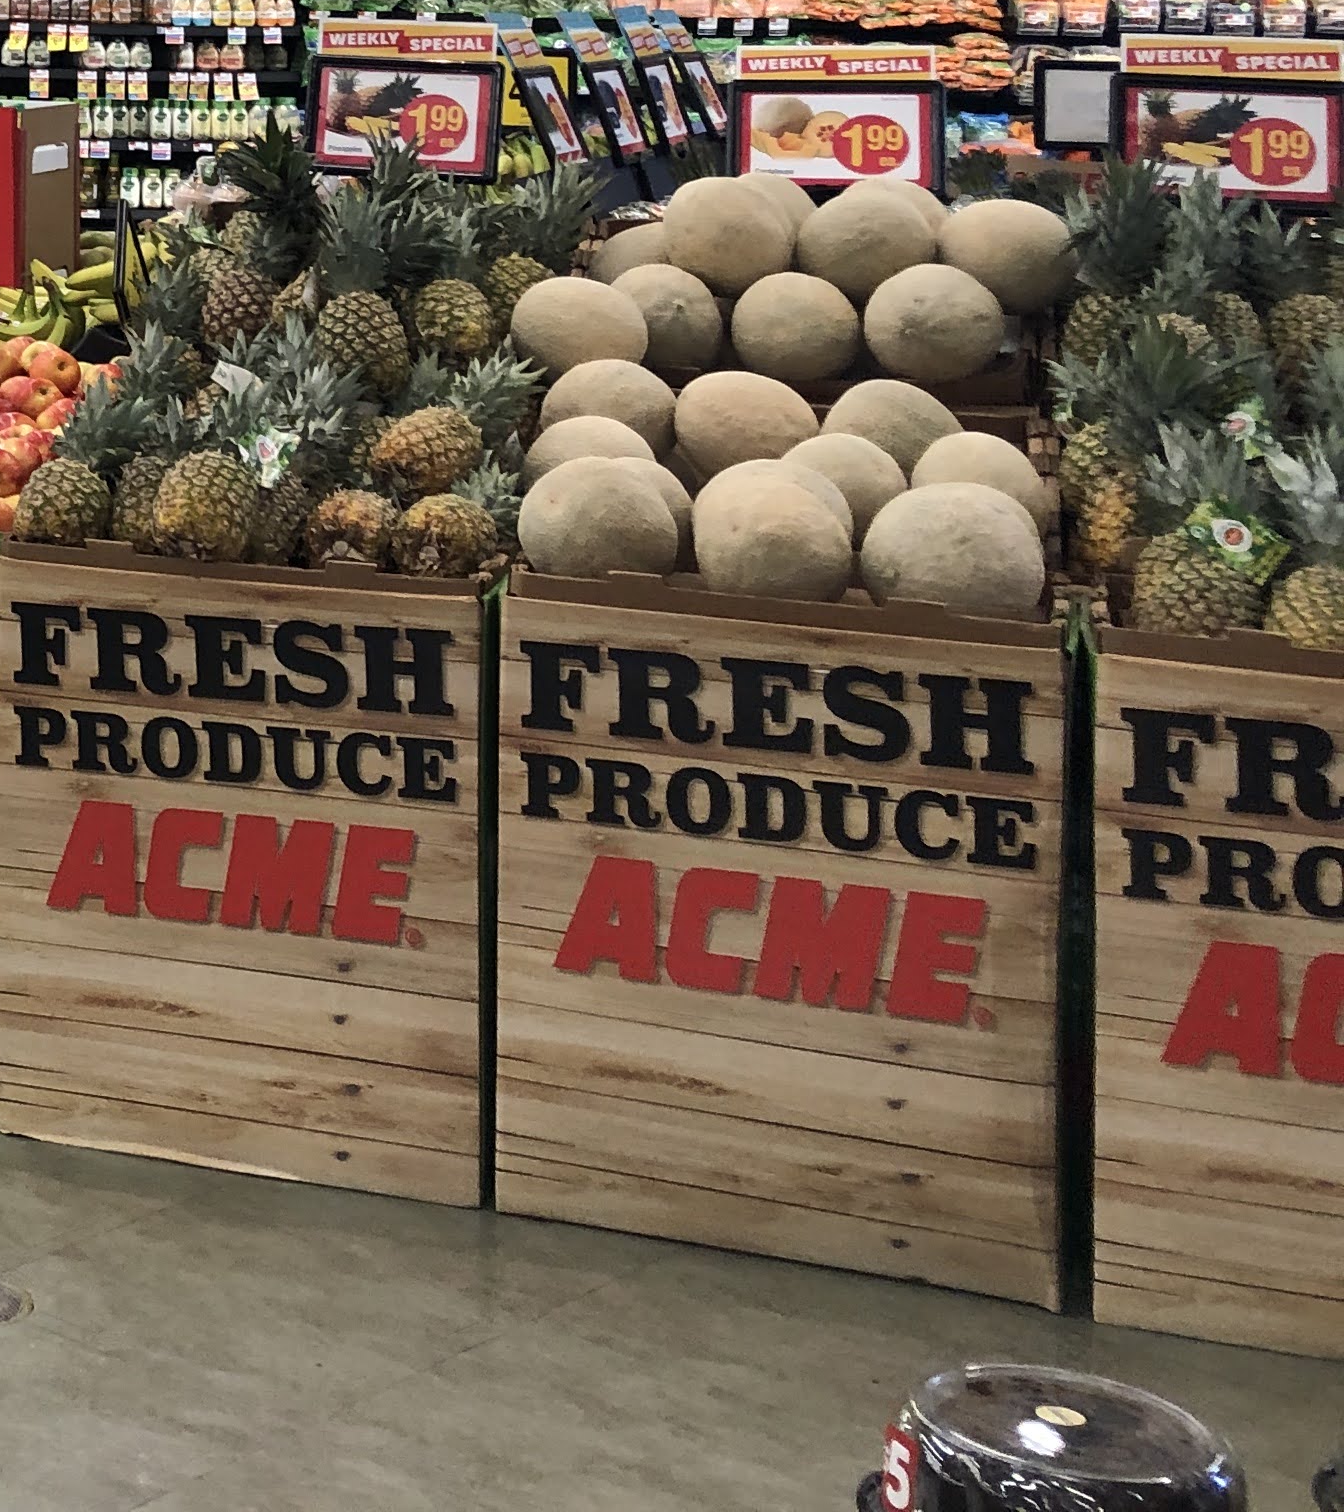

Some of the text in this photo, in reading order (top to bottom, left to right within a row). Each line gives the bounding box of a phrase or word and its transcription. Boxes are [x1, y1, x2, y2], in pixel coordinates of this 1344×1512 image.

[328, 31, 486, 51] WEEKLY SPECIAL
[748, 56, 922, 74] WEEKLY SPECIAL
[1134, 48, 1331, 71] WEEKLY SPECIAL
[12, 600, 455, 717] FRESH
[519, 639, 1035, 775] FRESH
[13, 704, 457, 803] PRODUCE
[520, 752, 1036, 870] PRODUCE
[47, 800, 416, 946] ACME
[553, 855, 988, 1026] ACME
